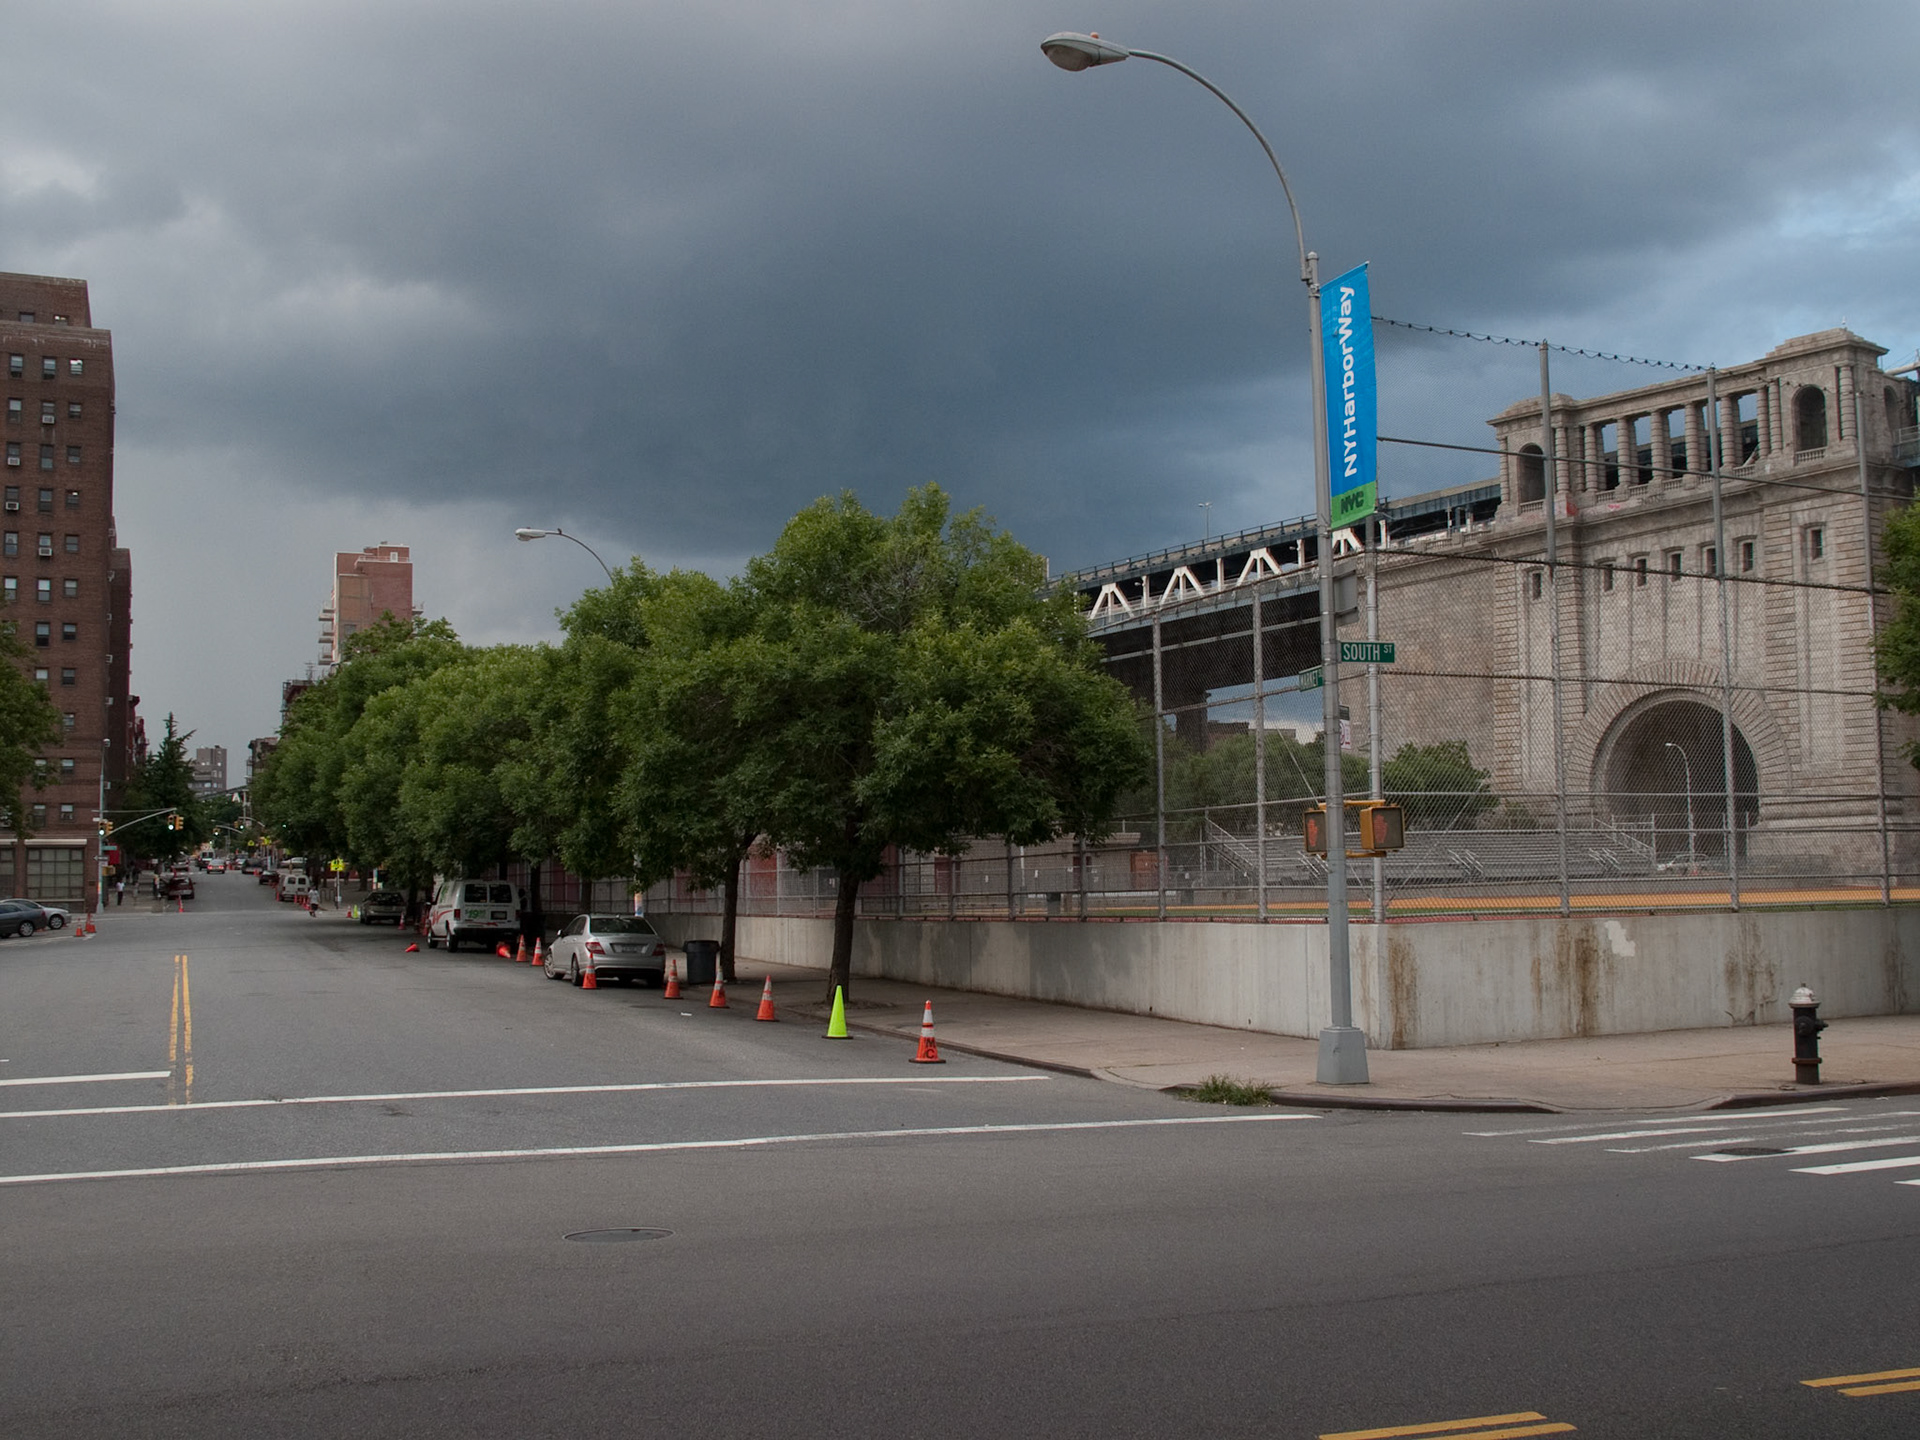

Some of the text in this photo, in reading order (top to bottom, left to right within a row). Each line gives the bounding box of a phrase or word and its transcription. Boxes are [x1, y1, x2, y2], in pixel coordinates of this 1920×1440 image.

[1338, 287, 1357, 477] NYHarborWay
[1341, 491, 1364, 514] NYC
[1343, 643, 1393, 661] SOUTH ST
